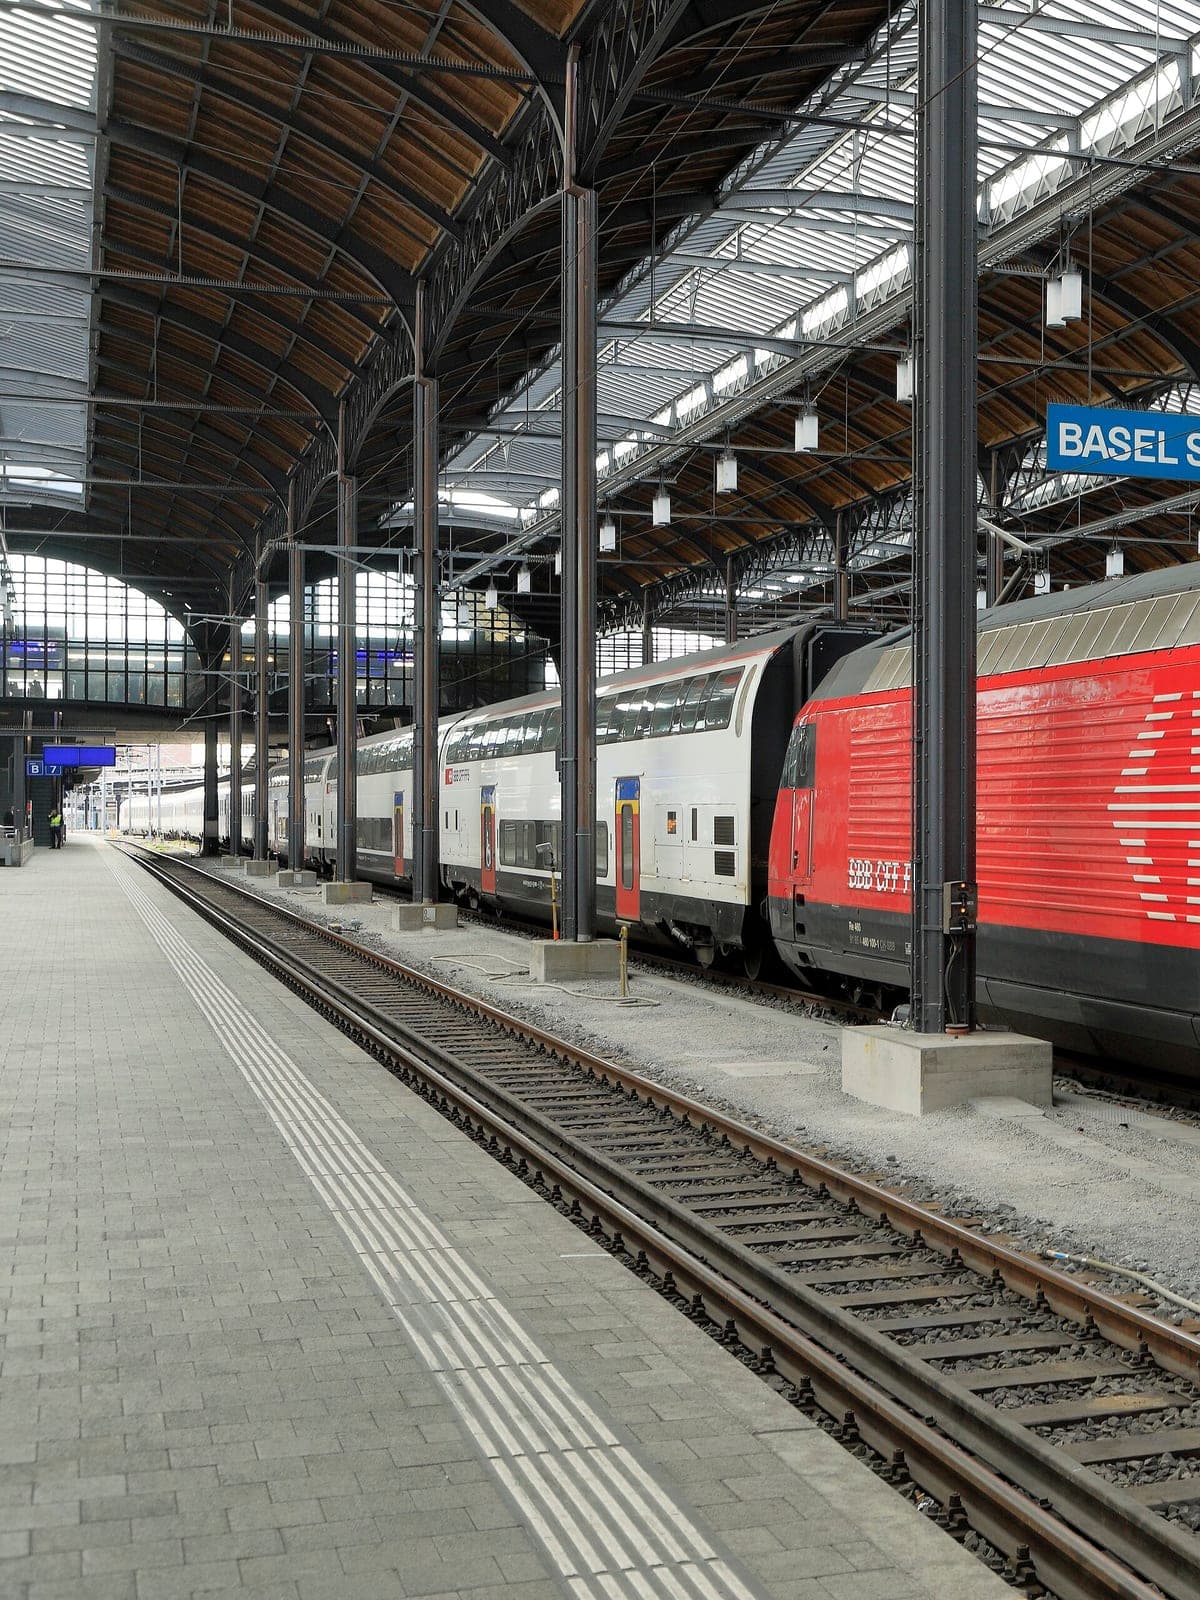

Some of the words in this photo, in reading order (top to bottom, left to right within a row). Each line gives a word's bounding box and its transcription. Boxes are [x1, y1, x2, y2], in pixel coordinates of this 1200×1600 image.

[1059, 422, 1178, 465] BASEL
[31, 764, 39, 774] B
[50, 765, 57, 774] 7
[848, 858, 873, 889] SBB
[876, 861, 899, 893] CFF
